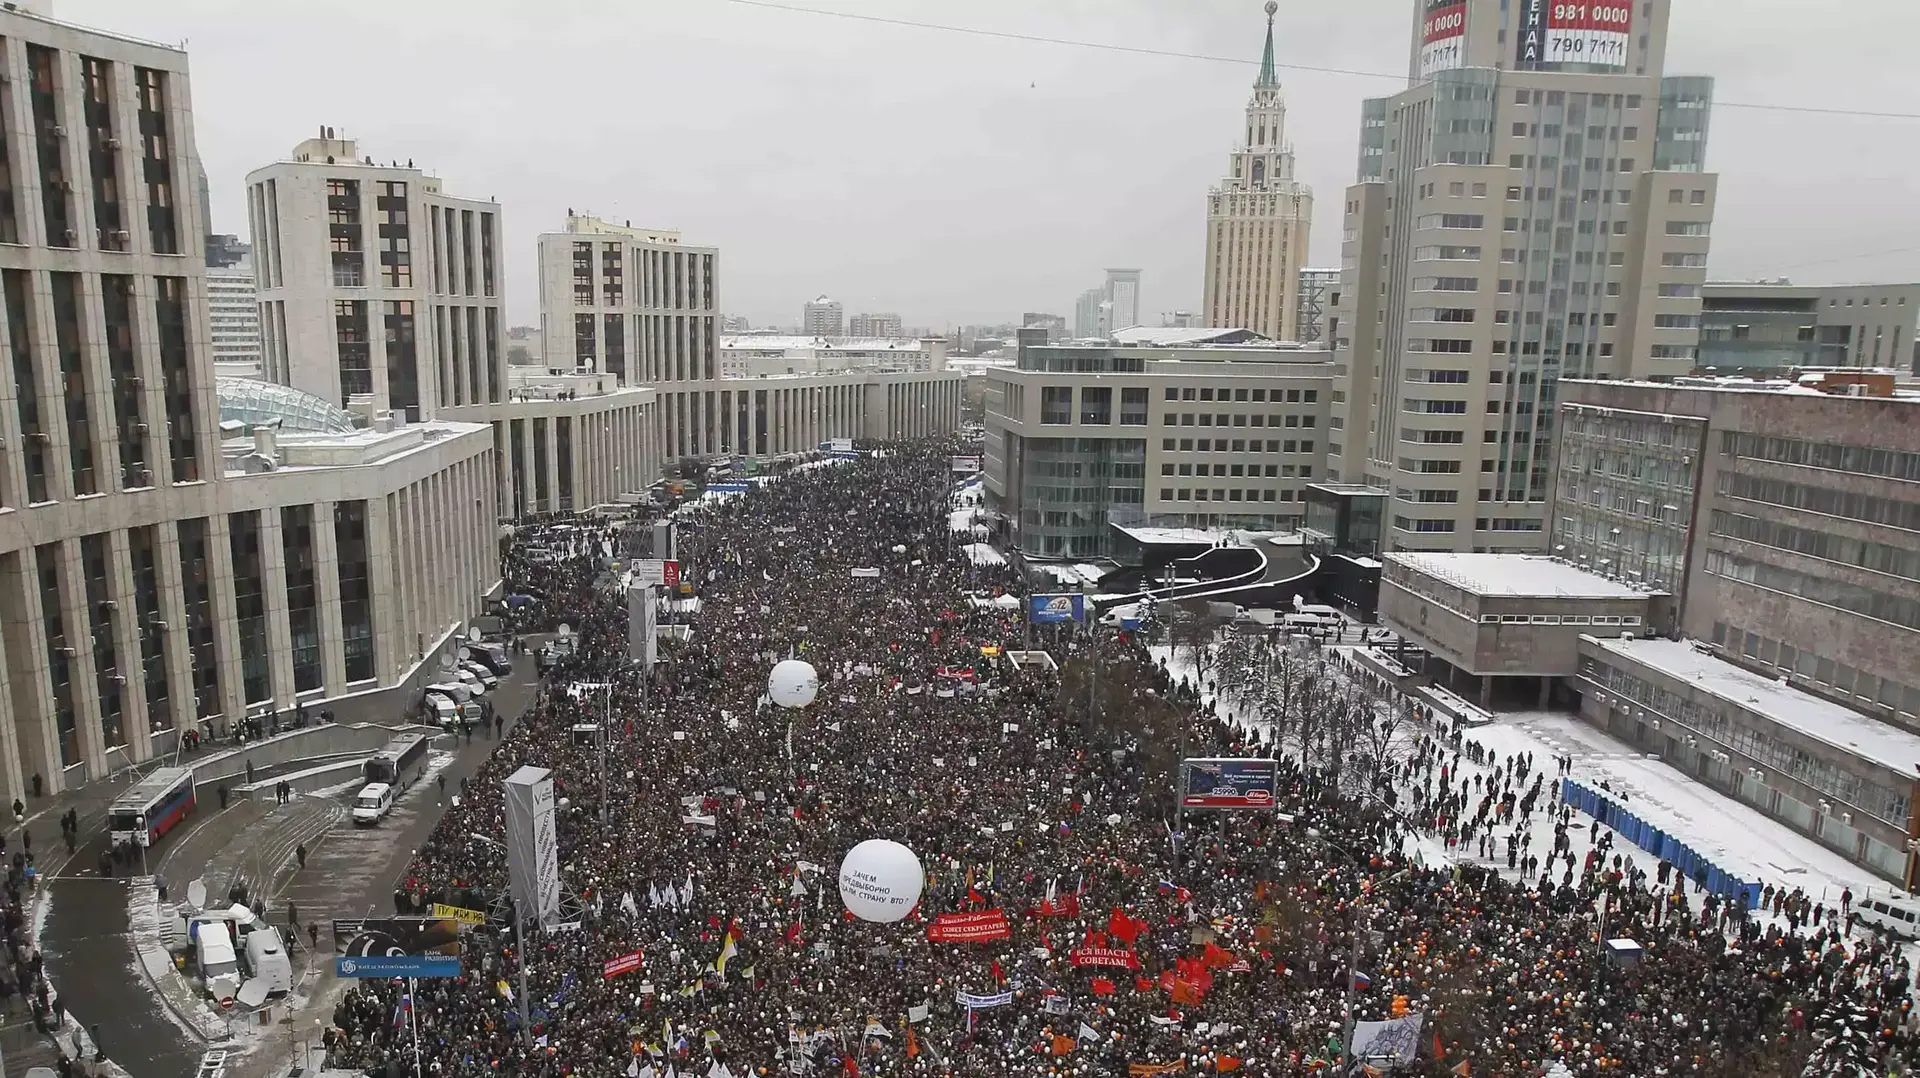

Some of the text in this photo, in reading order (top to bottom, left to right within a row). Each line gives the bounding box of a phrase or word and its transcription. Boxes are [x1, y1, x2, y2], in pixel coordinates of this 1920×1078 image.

[1434, 12, 1462, 32] 0000
[1554, 4, 1628, 24] 981 0000
[1433, 45, 1458, 64] 7171
[1552, 37, 1624, 56] 790 7171
[842, 875, 890, 894] ПРЕДВЫБОРНО
[853, 870, 877, 883] ЗАЧЕМ
[858, 892, 887, 903] СТРАНУ
[963, 922, 1005, 932] СЕКРЕТАРЕЙ
[1076, 948, 1131, 958] ВСЯ ВЛАСТЬ
[1079, 956, 1127, 966] СОВЕТАМ!
